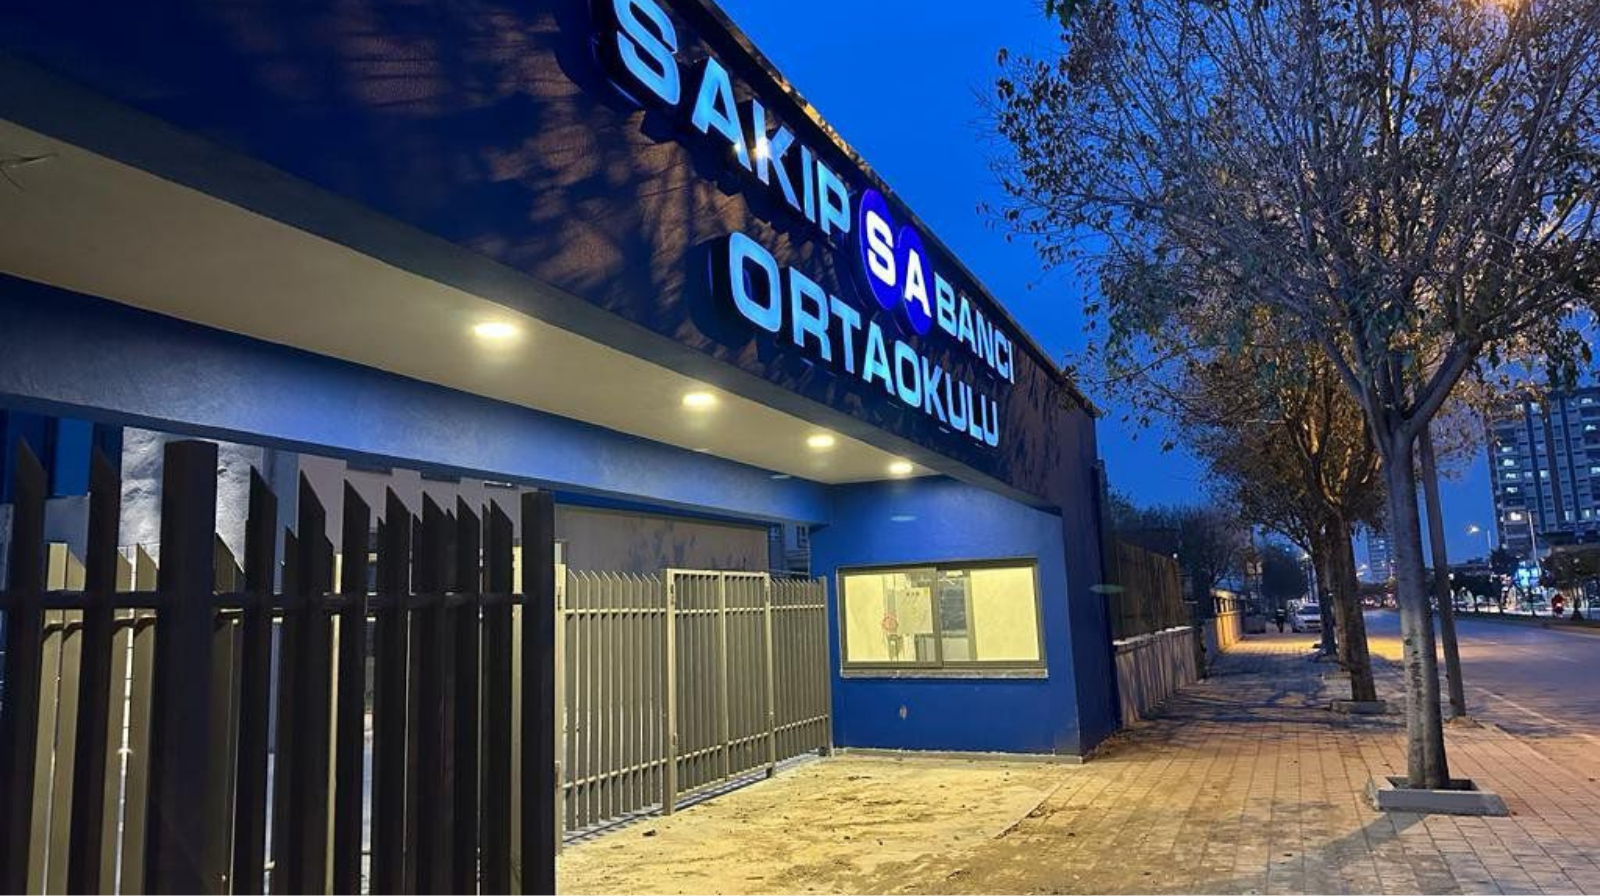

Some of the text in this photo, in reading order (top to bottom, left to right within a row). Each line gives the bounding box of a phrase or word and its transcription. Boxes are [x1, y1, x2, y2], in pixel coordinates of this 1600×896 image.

[614, 0, 1015, 385] SAKIP SABANCI
[729, 232, 999, 448] ORTAOKULU
